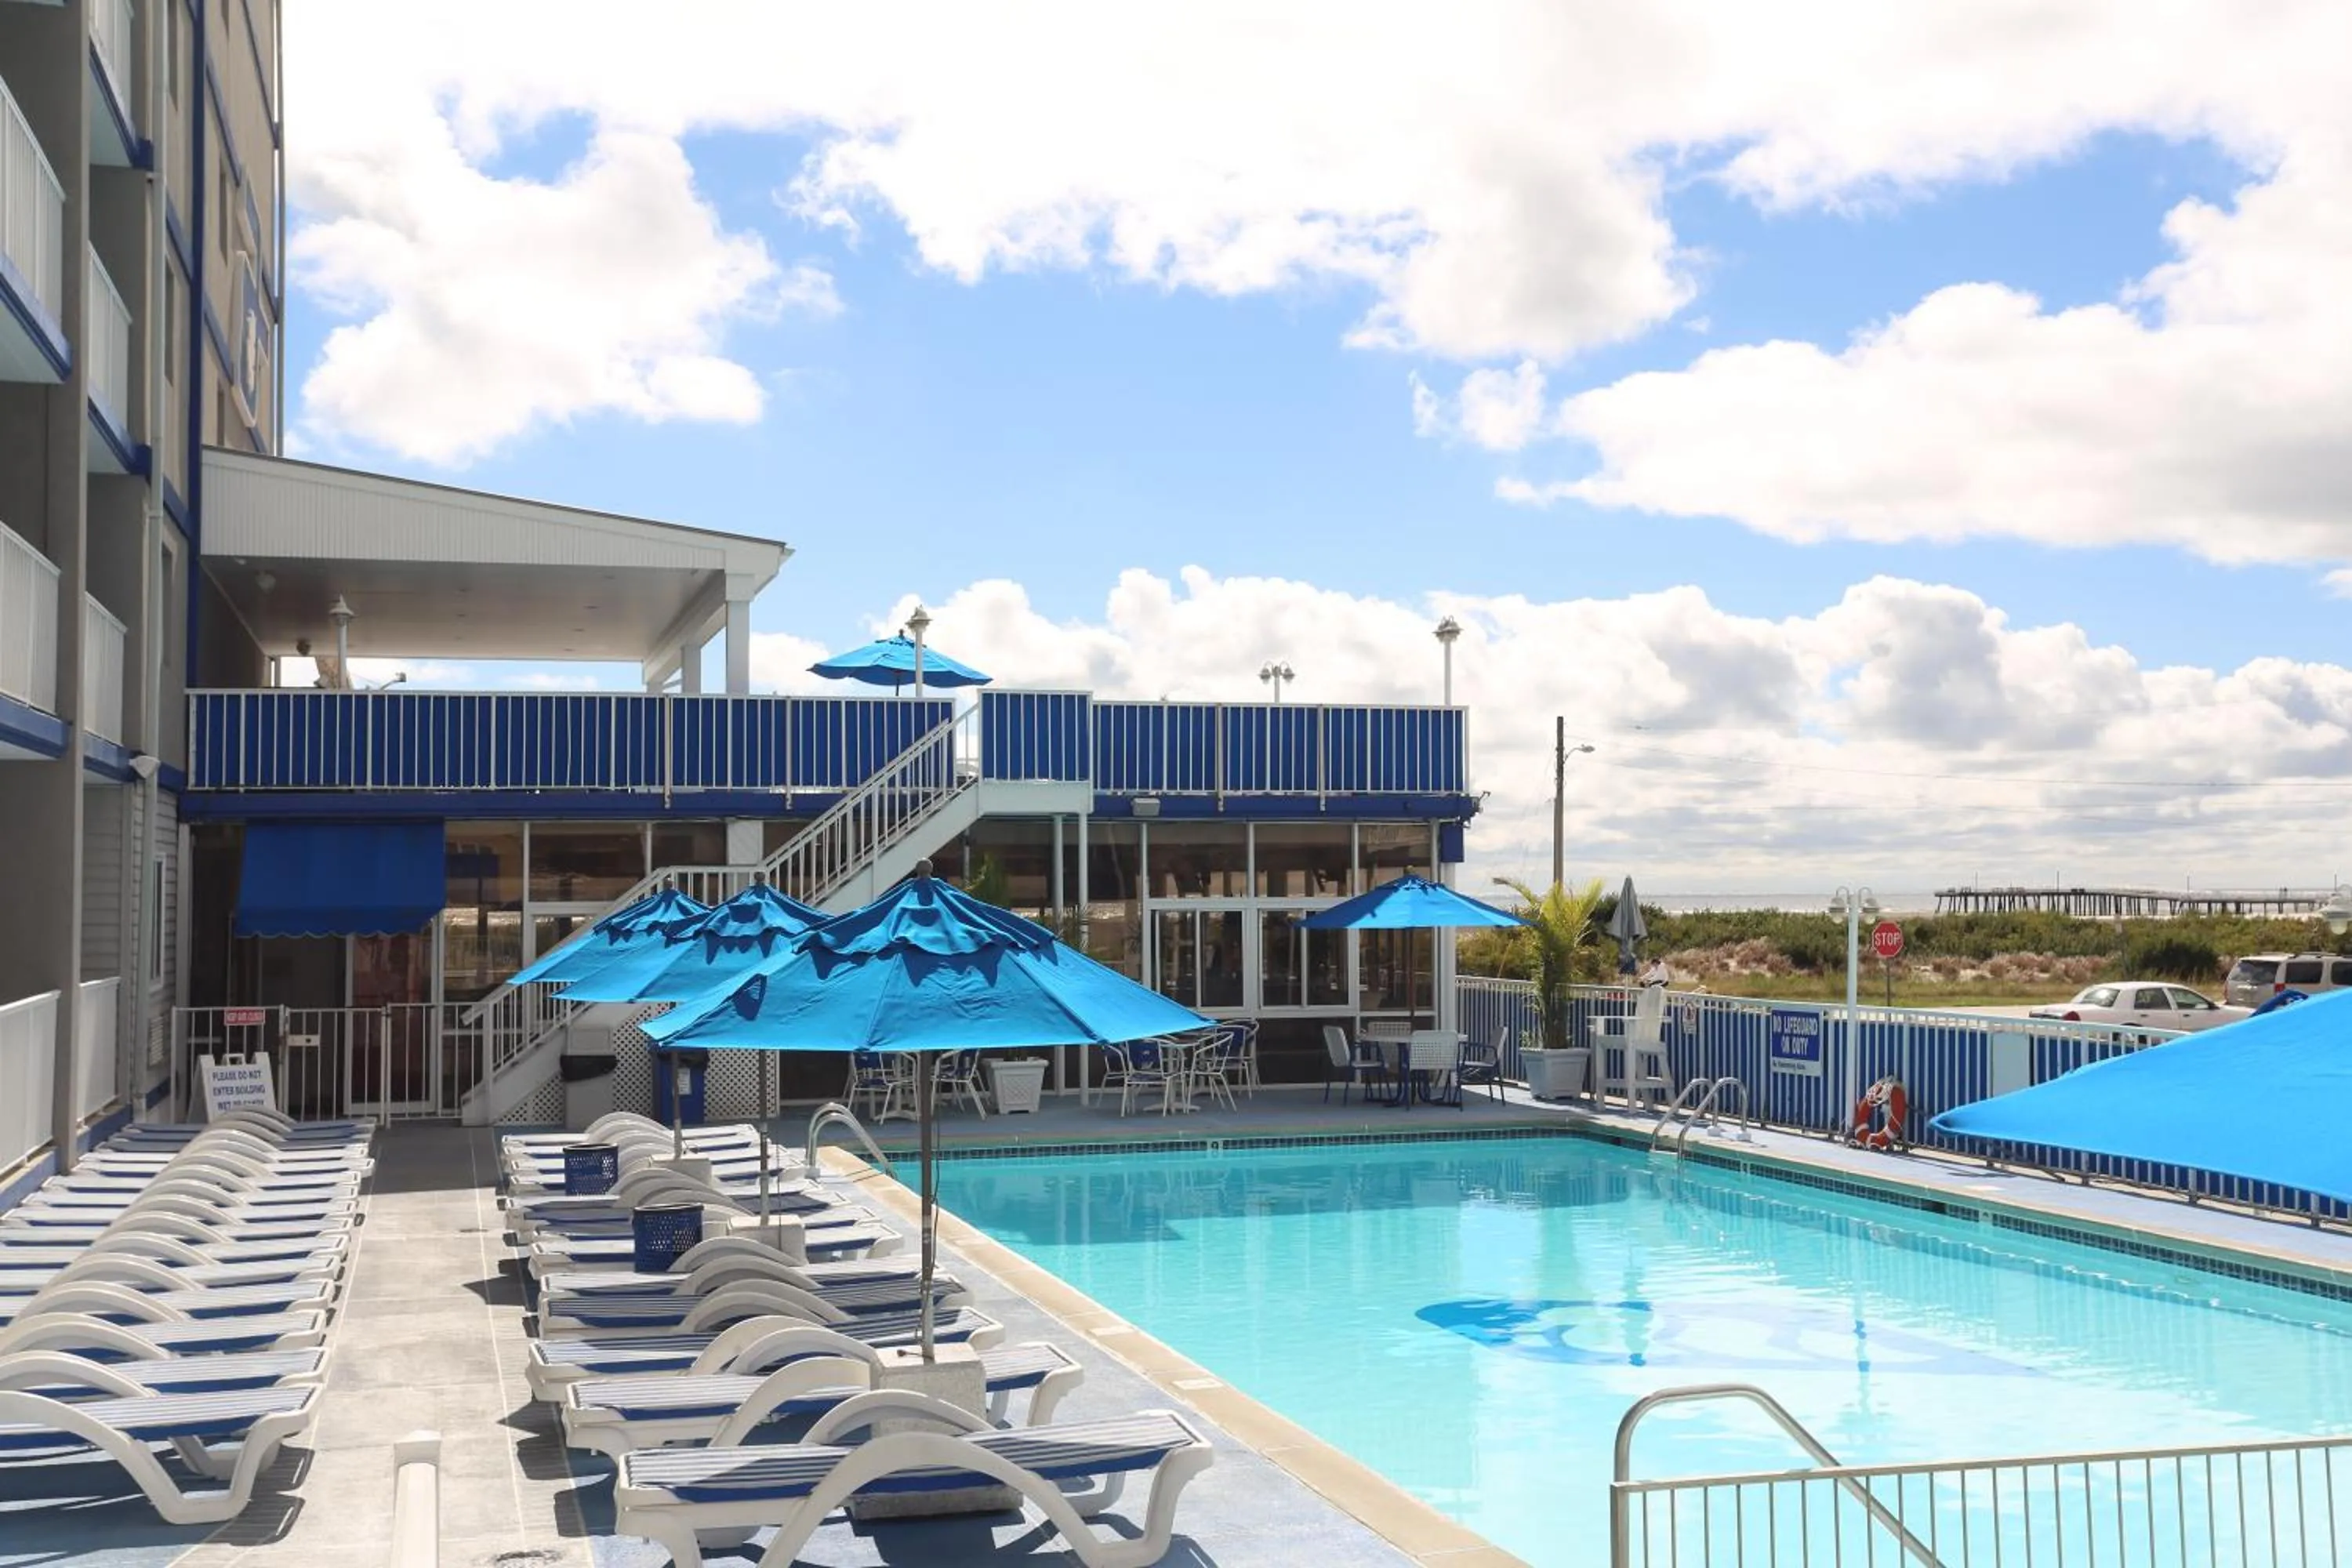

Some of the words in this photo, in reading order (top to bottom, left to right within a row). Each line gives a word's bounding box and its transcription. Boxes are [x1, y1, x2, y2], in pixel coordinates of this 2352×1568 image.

[1875, 932, 1900, 946] STOP
[1784, 1016, 1818, 1035] LIFEGUARD
[1781, 1036, 1790, 1054] ON
[1792, 1037, 1809, 1056] DUTY
[212, 1071, 237, 1081] PLEASE
[238, 1071, 248, 1080] DO
[249, 1070, 261, 1080] NOT
[213, 1087, 234, 1096] ENTER
[235, 1084, 266, 1094] BUILDING
